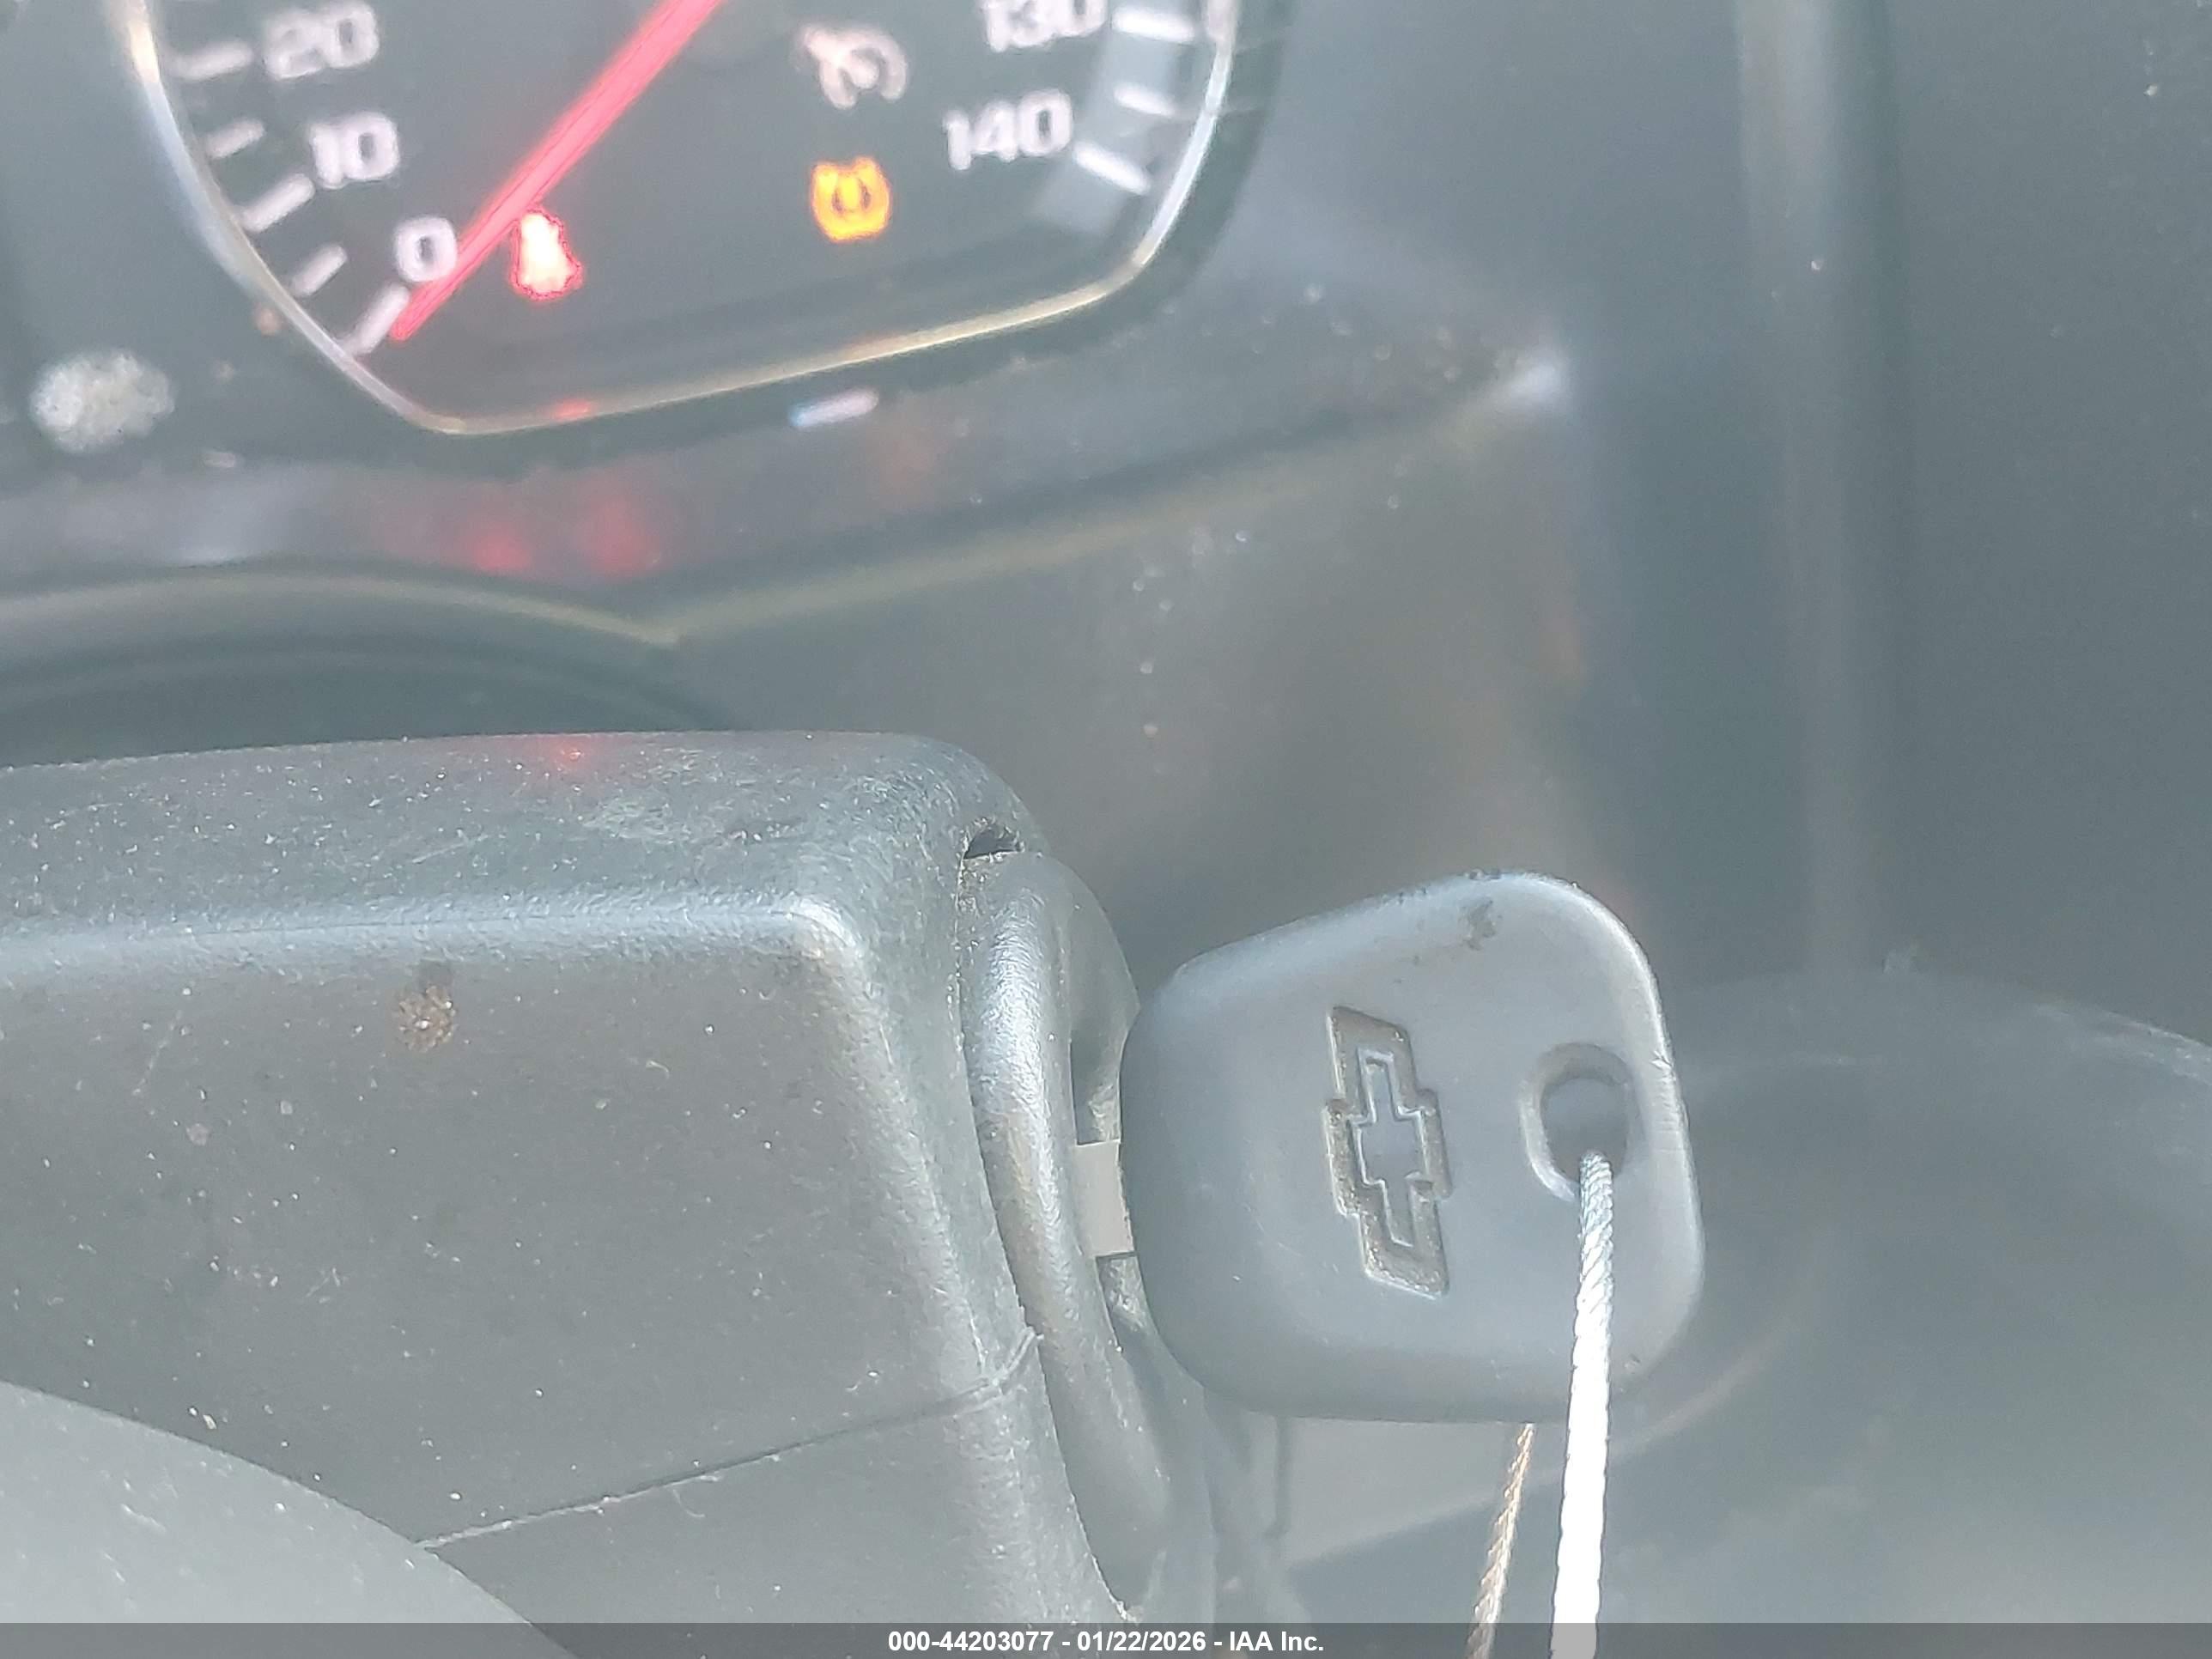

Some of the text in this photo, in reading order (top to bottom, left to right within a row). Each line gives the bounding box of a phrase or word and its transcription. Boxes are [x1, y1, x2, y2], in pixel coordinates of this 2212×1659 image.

[264, 2, 380, 79] 20
[308, 112, 398, 187] 10
[946, 89, 1073, 170] 140
[394, 216, 458, 282] 0
